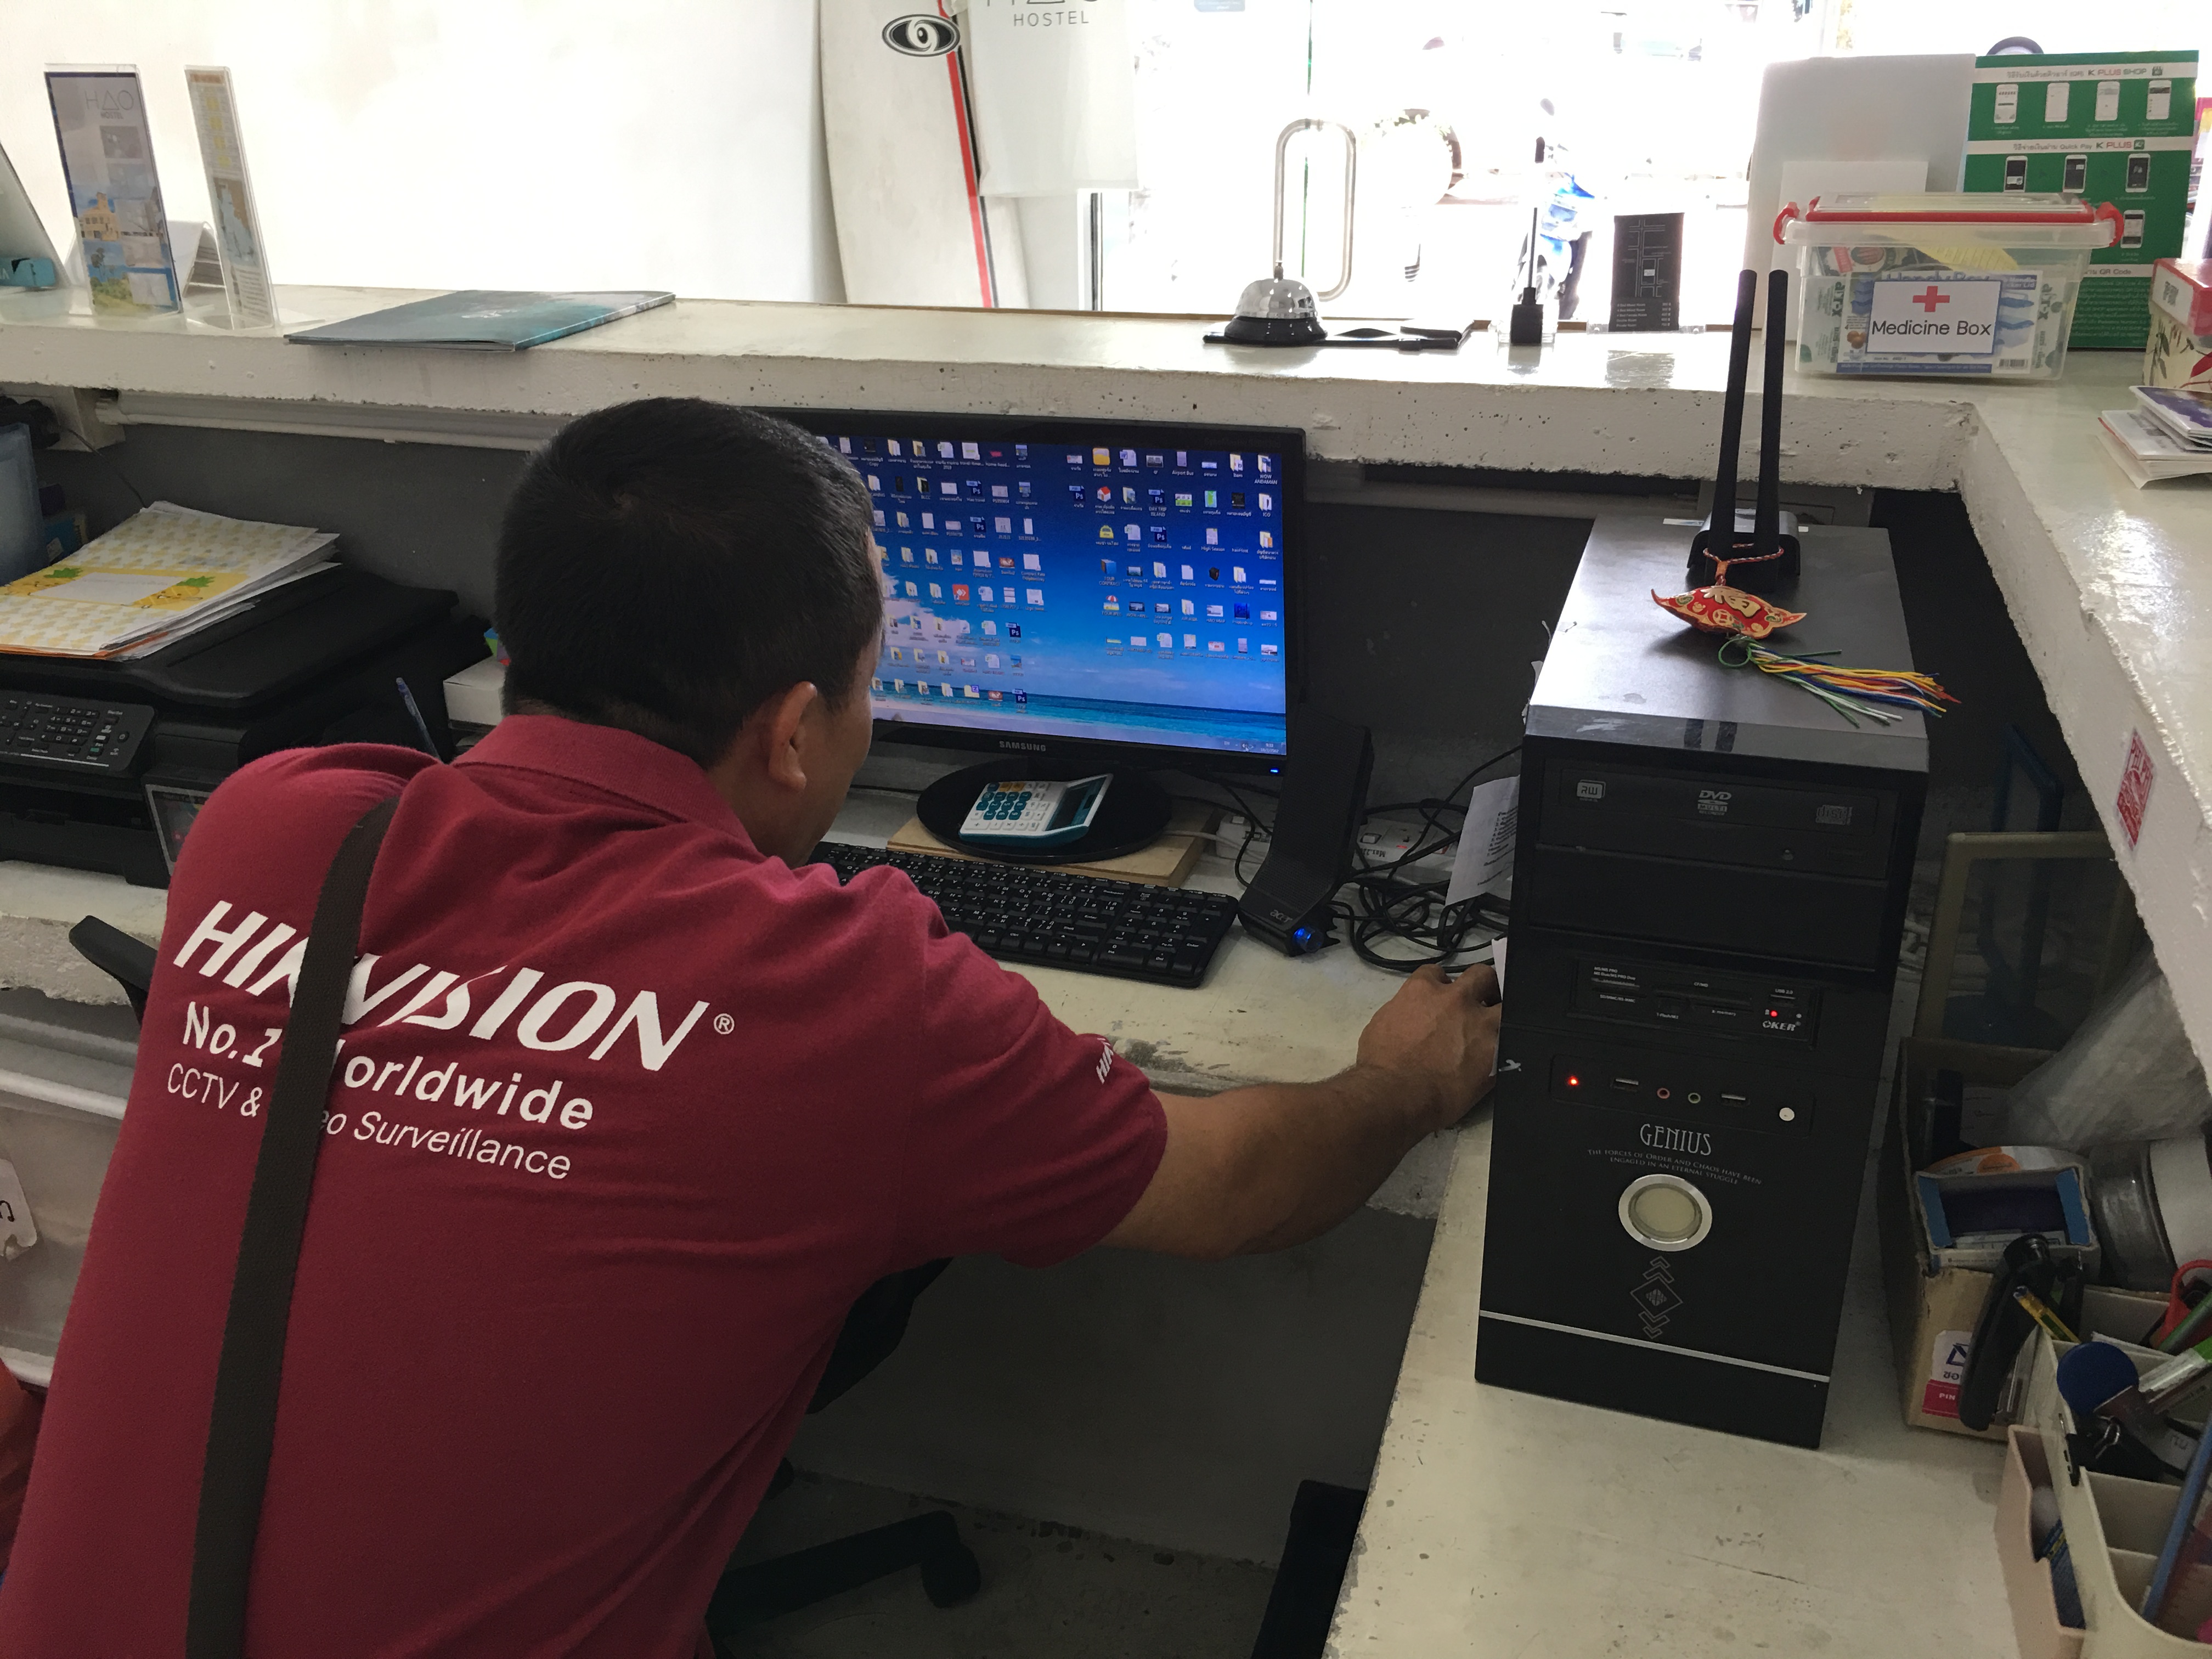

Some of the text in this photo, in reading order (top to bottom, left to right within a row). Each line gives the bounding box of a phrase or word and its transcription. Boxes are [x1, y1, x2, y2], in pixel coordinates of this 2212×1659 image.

[1013, 10, 1089, 27] HOSTEL
[1871, 319, 1950, 335] Medicine
[1956, 320, 1991, 336] Box
[999, 741, 1046, 752] SAMSUNG
[1581, 786, 1598, 795] RW
[1699, 790, 1731, 800] DVD
[1270, 909, 1293, 923] acer
[333, 1039, 594, 1131] orldwide
[166, 1062, 239, 1109] CCTV
[240, 1085, 263, 1118] &
[353, 1110, 571, 1180] Surveillance
[1639, 1123, 1712, 1156] GENIUS
[1610, 1157, 1645, 1166] ENGAGED
[1672, 1165, 1703, 1176] ETERNAL
[1674, 1158, 1691, 1167] AND
[1722, 1169, 1741, 1178] HAVE
[1743, 1175, 1762, 1185] BEEN
